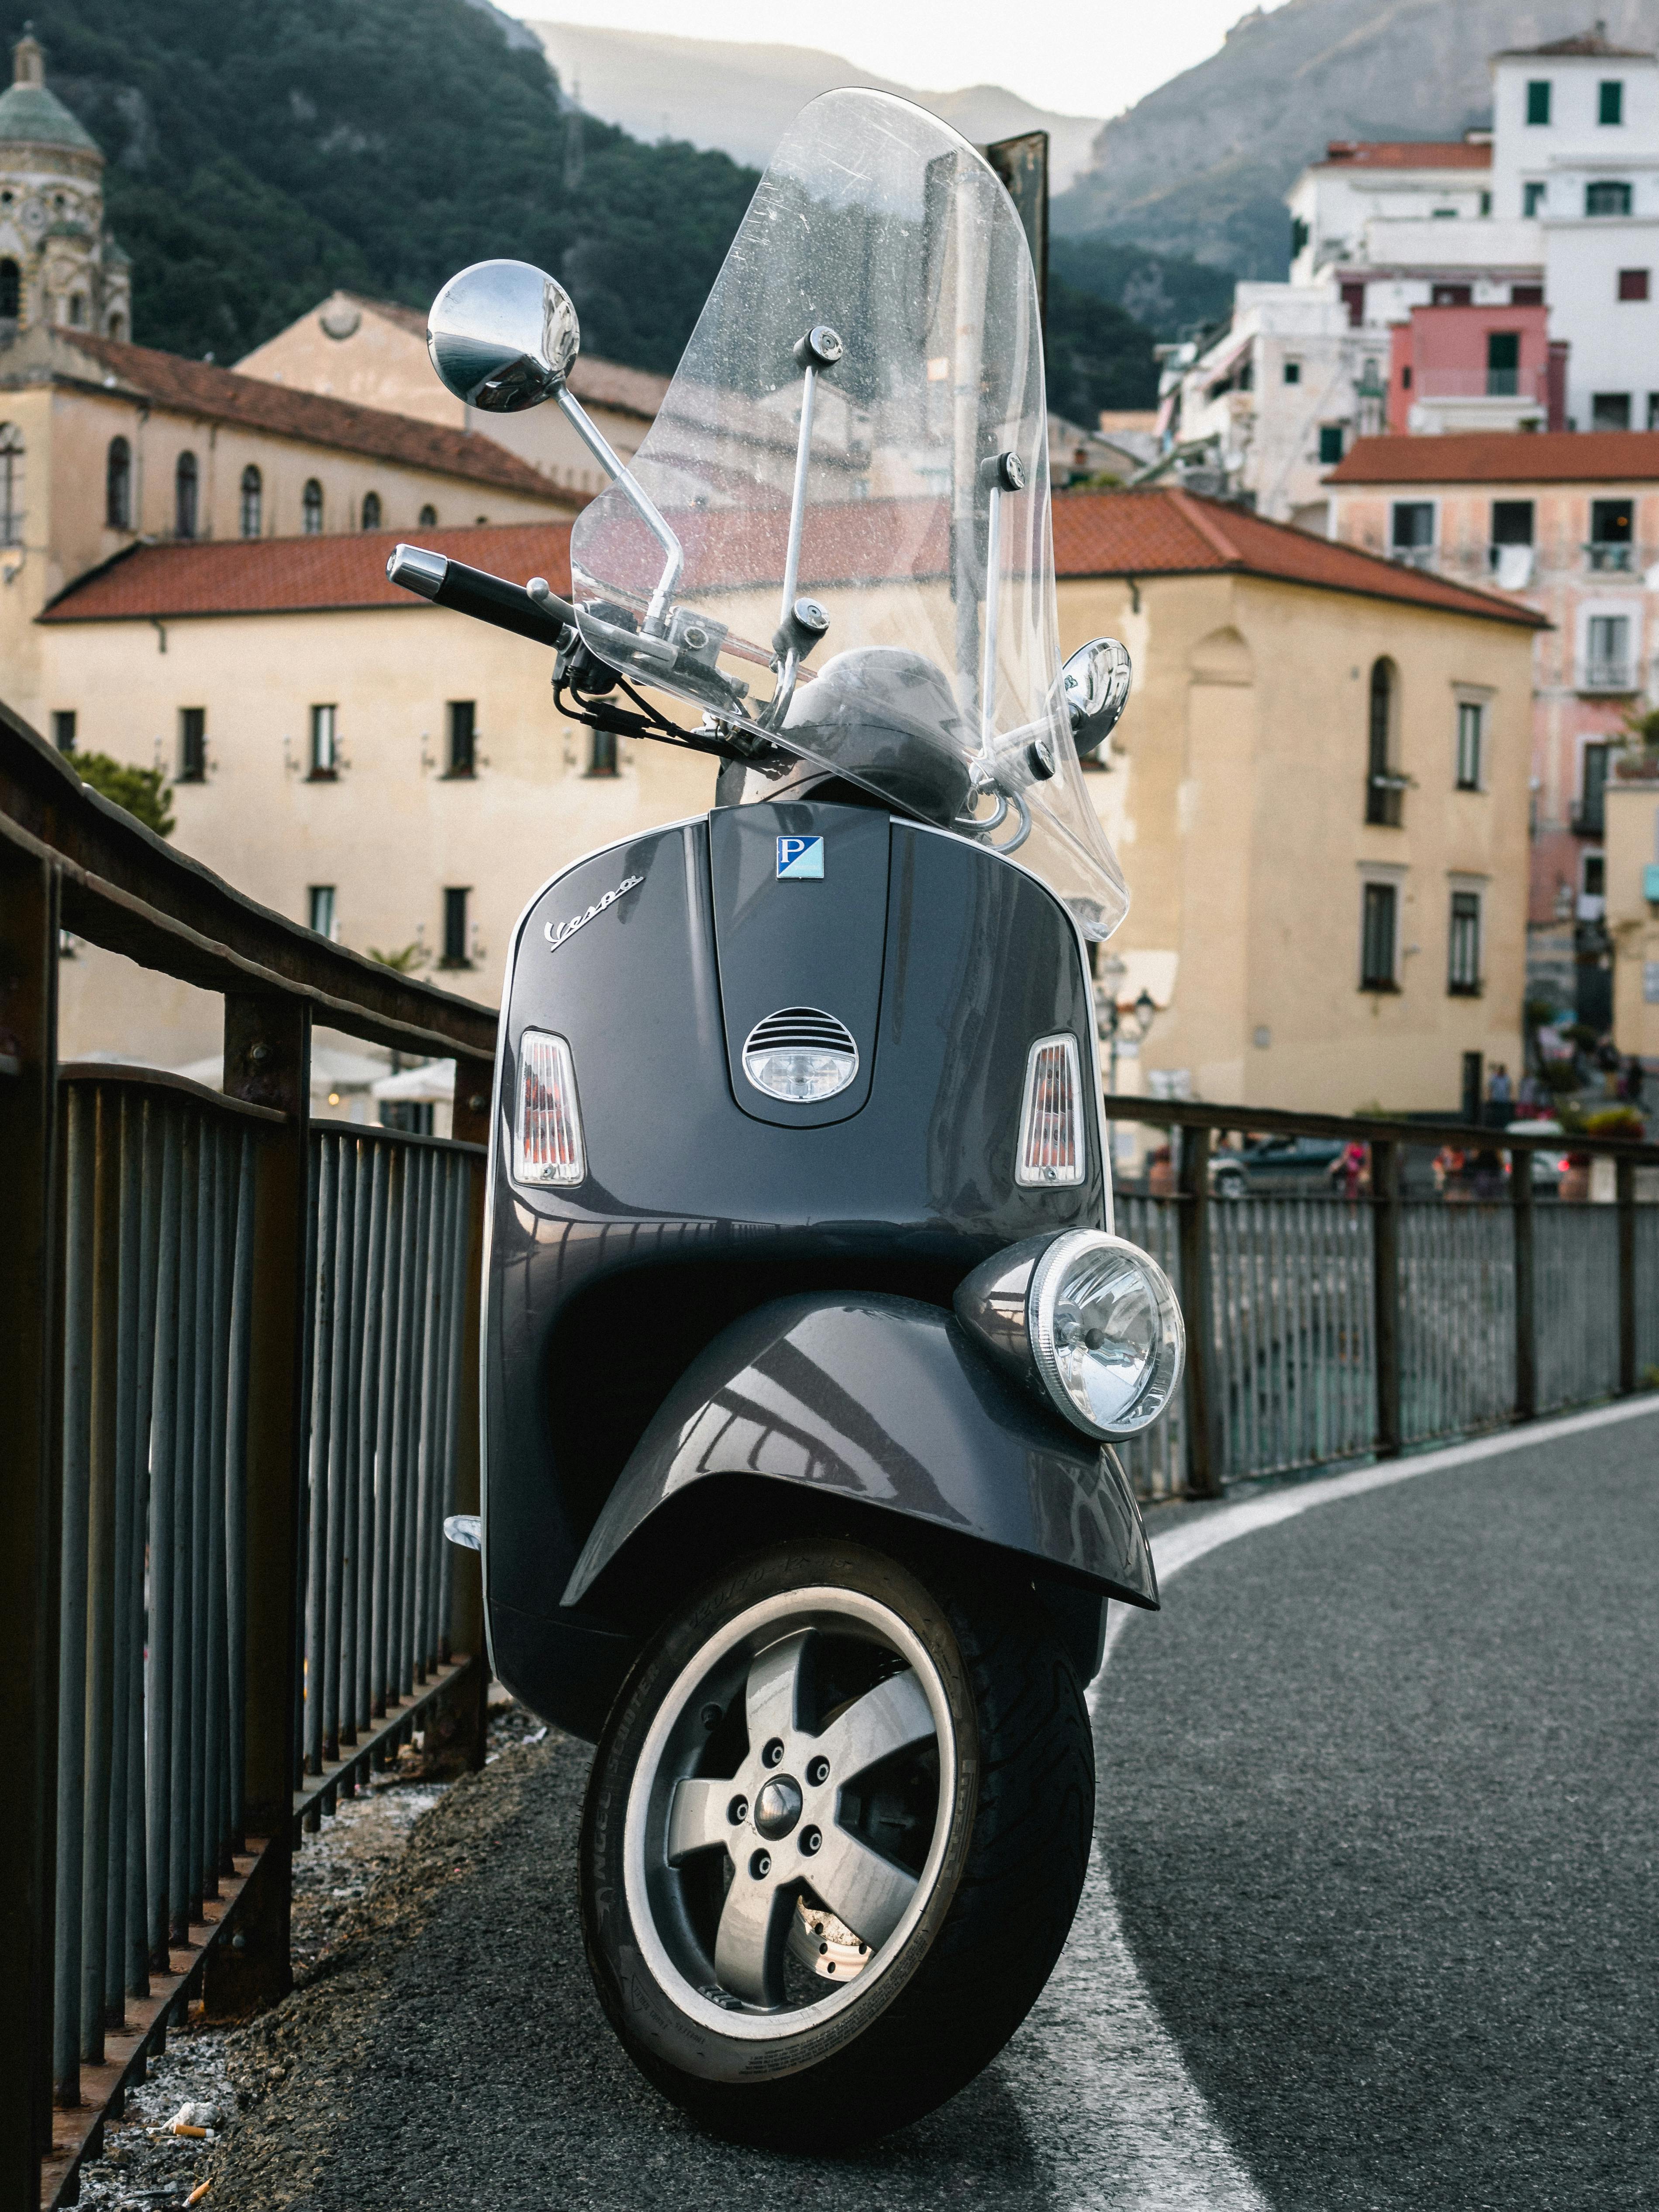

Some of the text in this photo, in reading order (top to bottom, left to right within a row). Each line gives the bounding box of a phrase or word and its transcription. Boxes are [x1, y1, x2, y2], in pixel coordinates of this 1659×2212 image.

[781, 839, 804, 863] P
[544, 876, 645, 951] Vespa
[607, 1663, 659, 1773] SCOOTER
